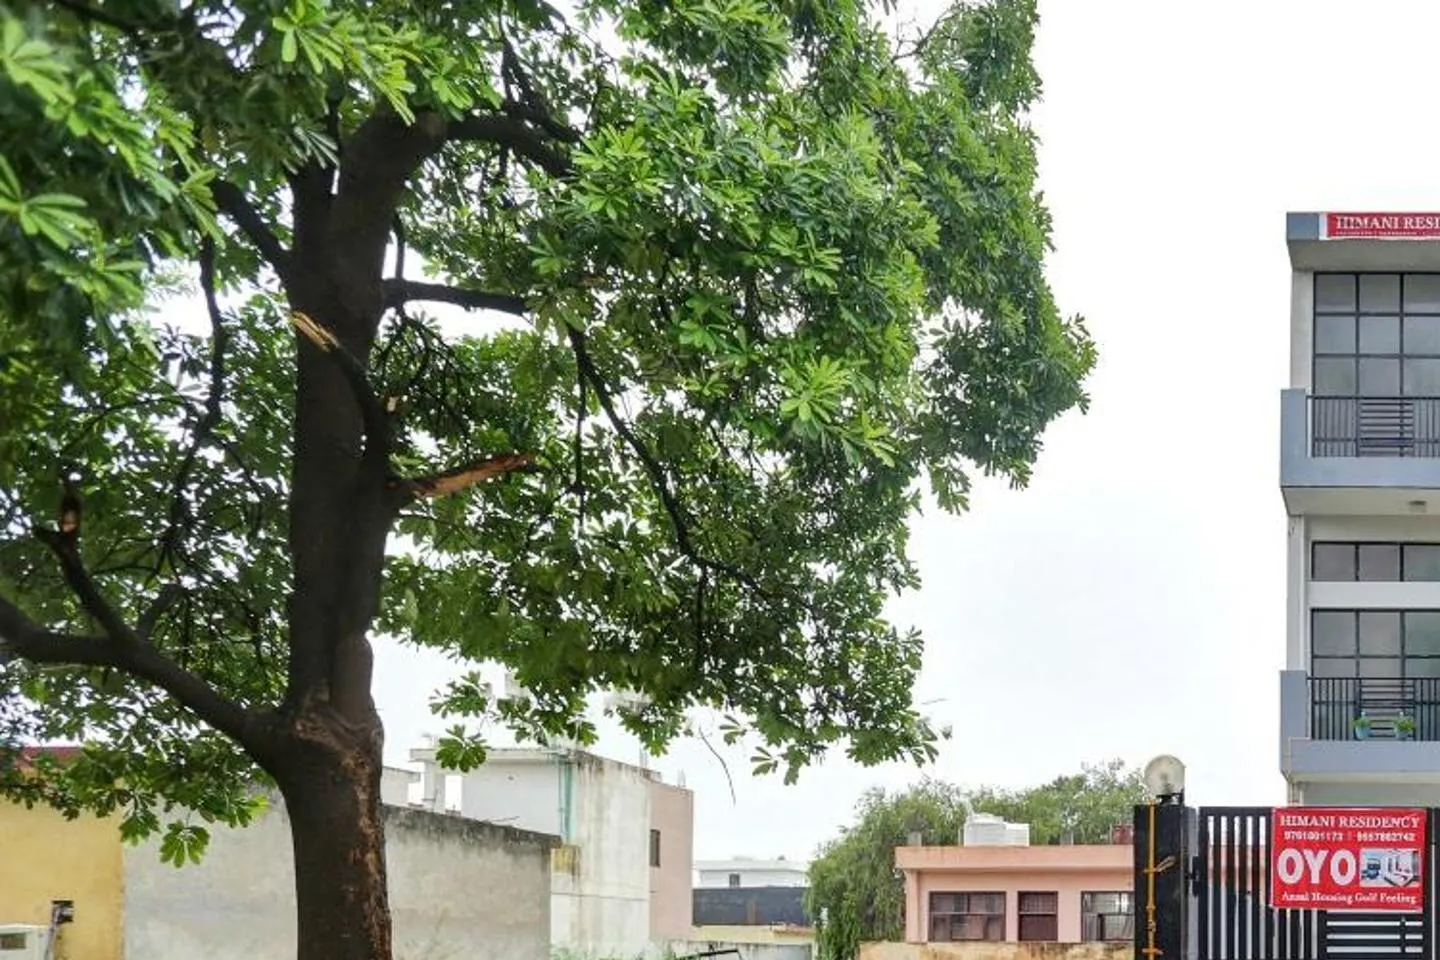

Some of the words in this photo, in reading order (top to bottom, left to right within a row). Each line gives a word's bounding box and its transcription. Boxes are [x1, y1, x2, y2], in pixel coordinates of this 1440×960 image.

[1280, 815, 1335, 828] HIMANI
[1338, 816, 1420, 829] RESIDENCY
[1277, 847, 1356, 886] OYO
[1380, 893, 1416, 905] Feeling
